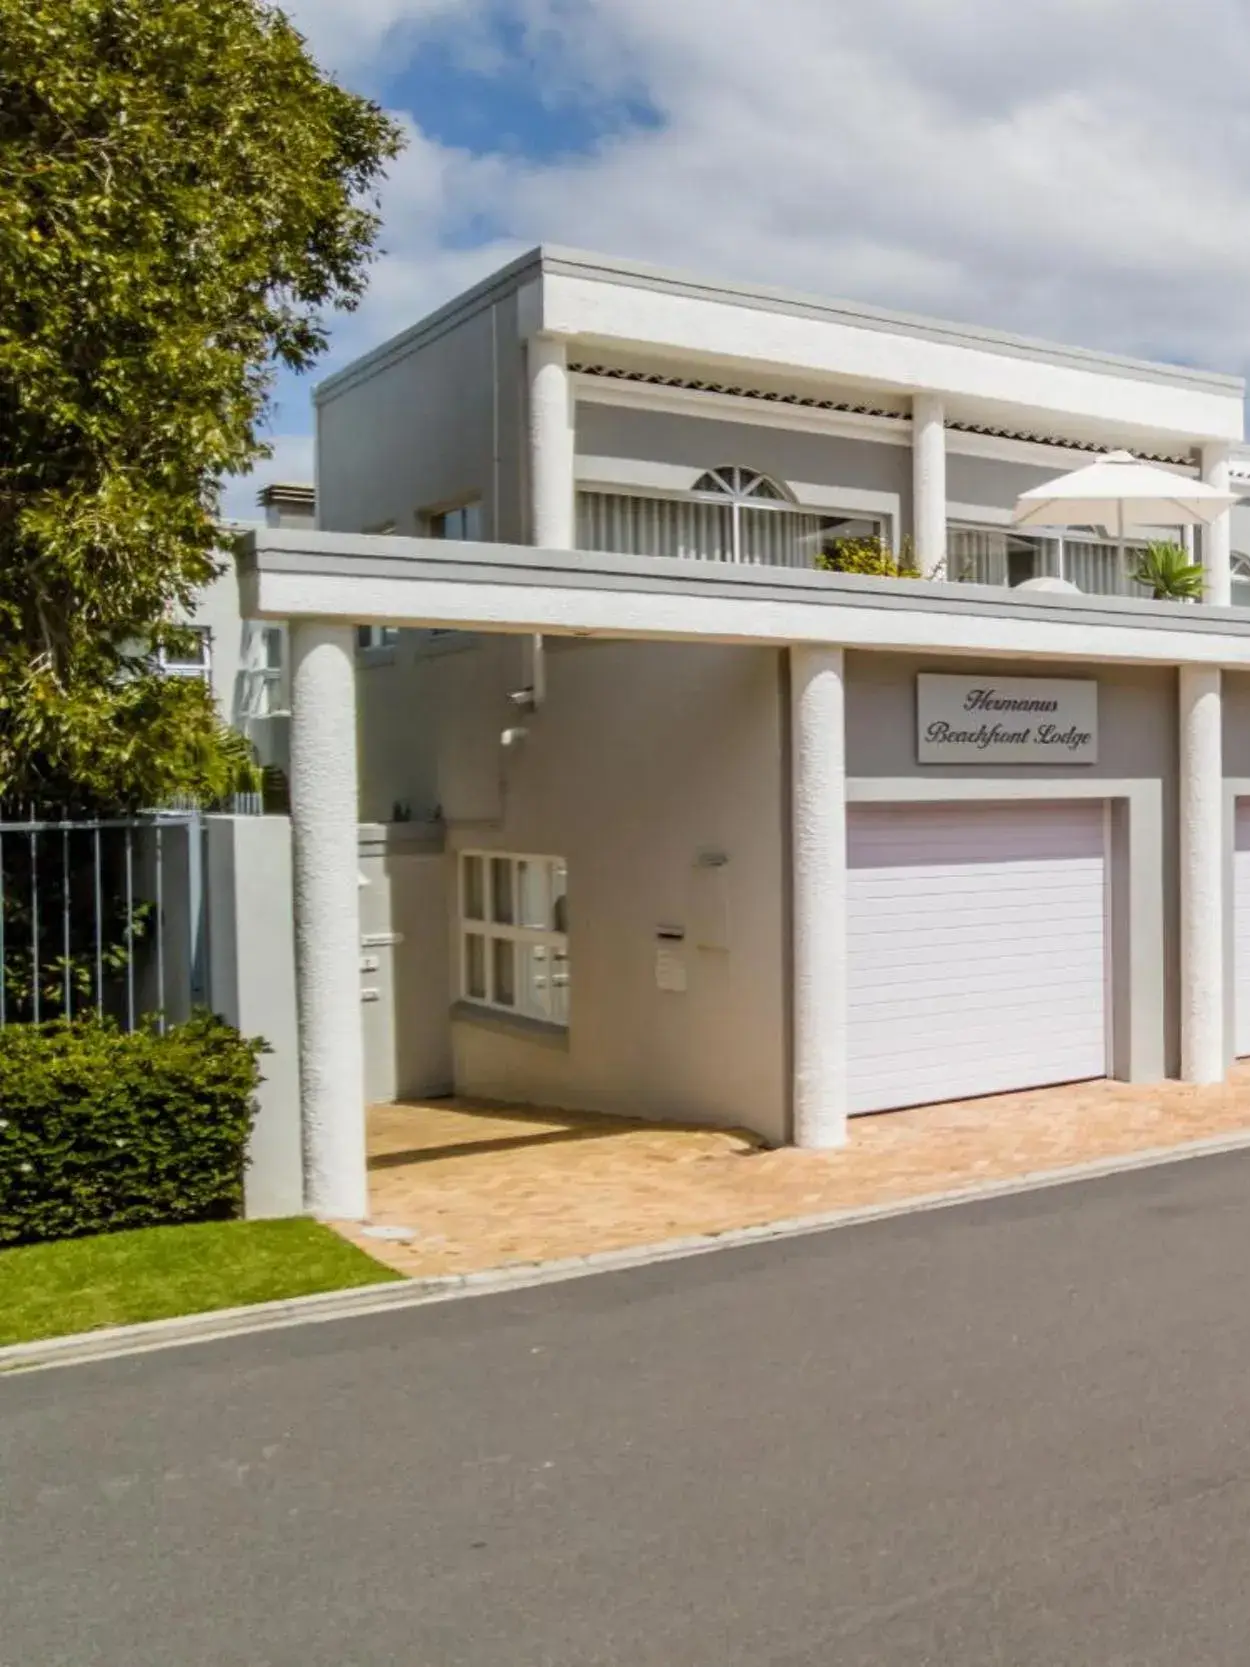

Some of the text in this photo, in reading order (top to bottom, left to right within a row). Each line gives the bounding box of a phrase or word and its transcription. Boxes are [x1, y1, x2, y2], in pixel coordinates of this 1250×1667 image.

[963, 689, 1058, 712] Hermanus
[925, 721, 1092, 750] Beachfront Lodge
